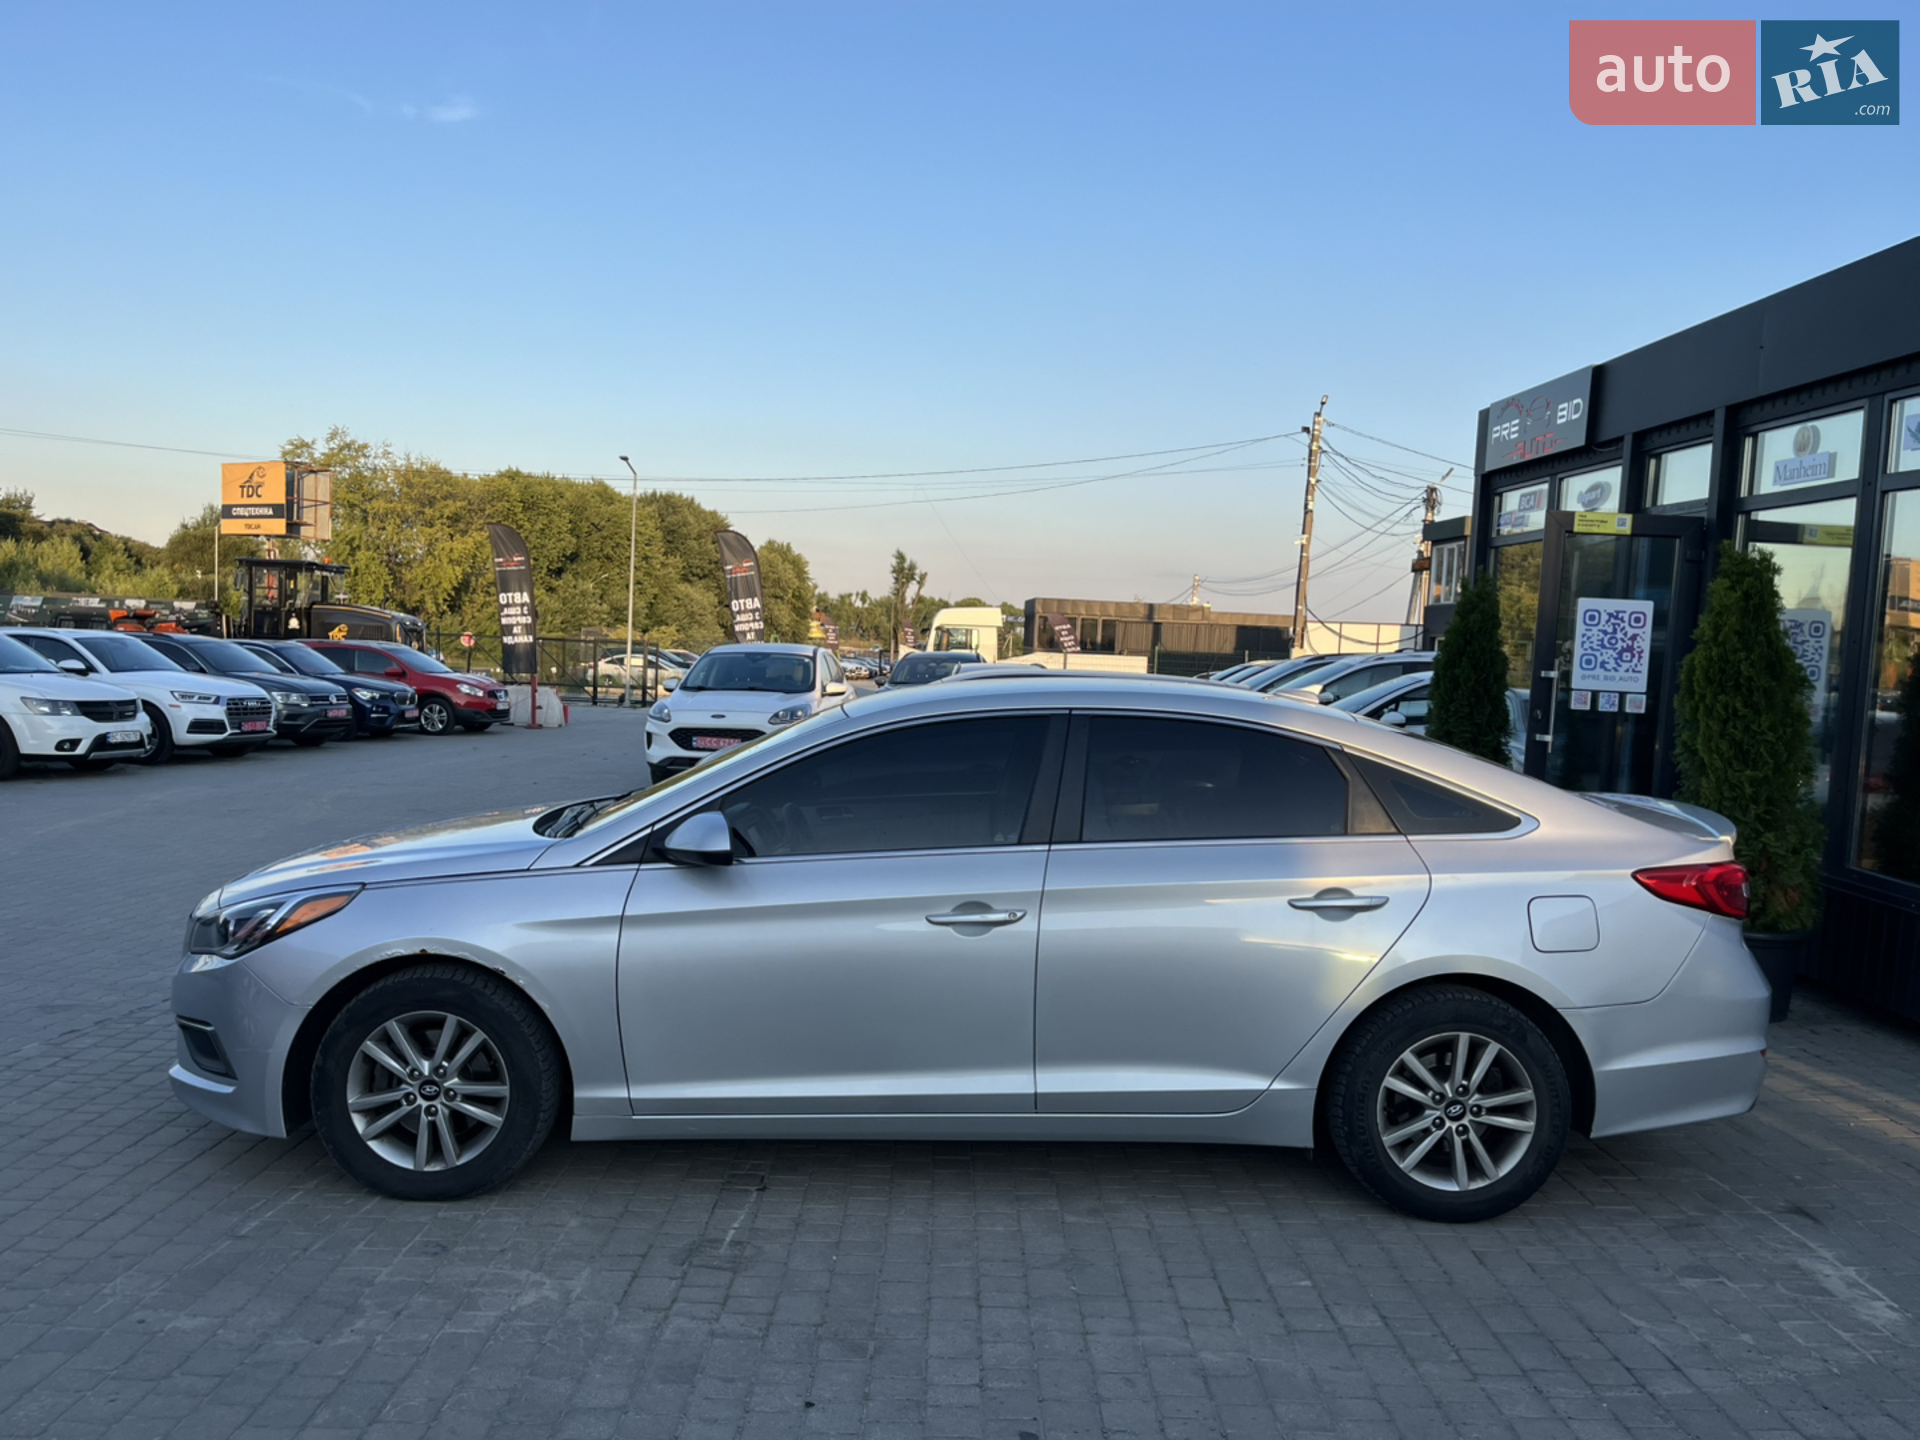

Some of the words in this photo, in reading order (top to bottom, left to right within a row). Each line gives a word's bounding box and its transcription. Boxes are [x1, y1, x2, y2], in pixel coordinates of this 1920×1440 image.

[1491, 419, 1521, 445] PRE
[1557, 397, 1584, 425] BID
[1773, 456, 1828, 484] Manheim
[239, 484, 262, 498] TDC
[1519, 494, 1535, 511] BCA
